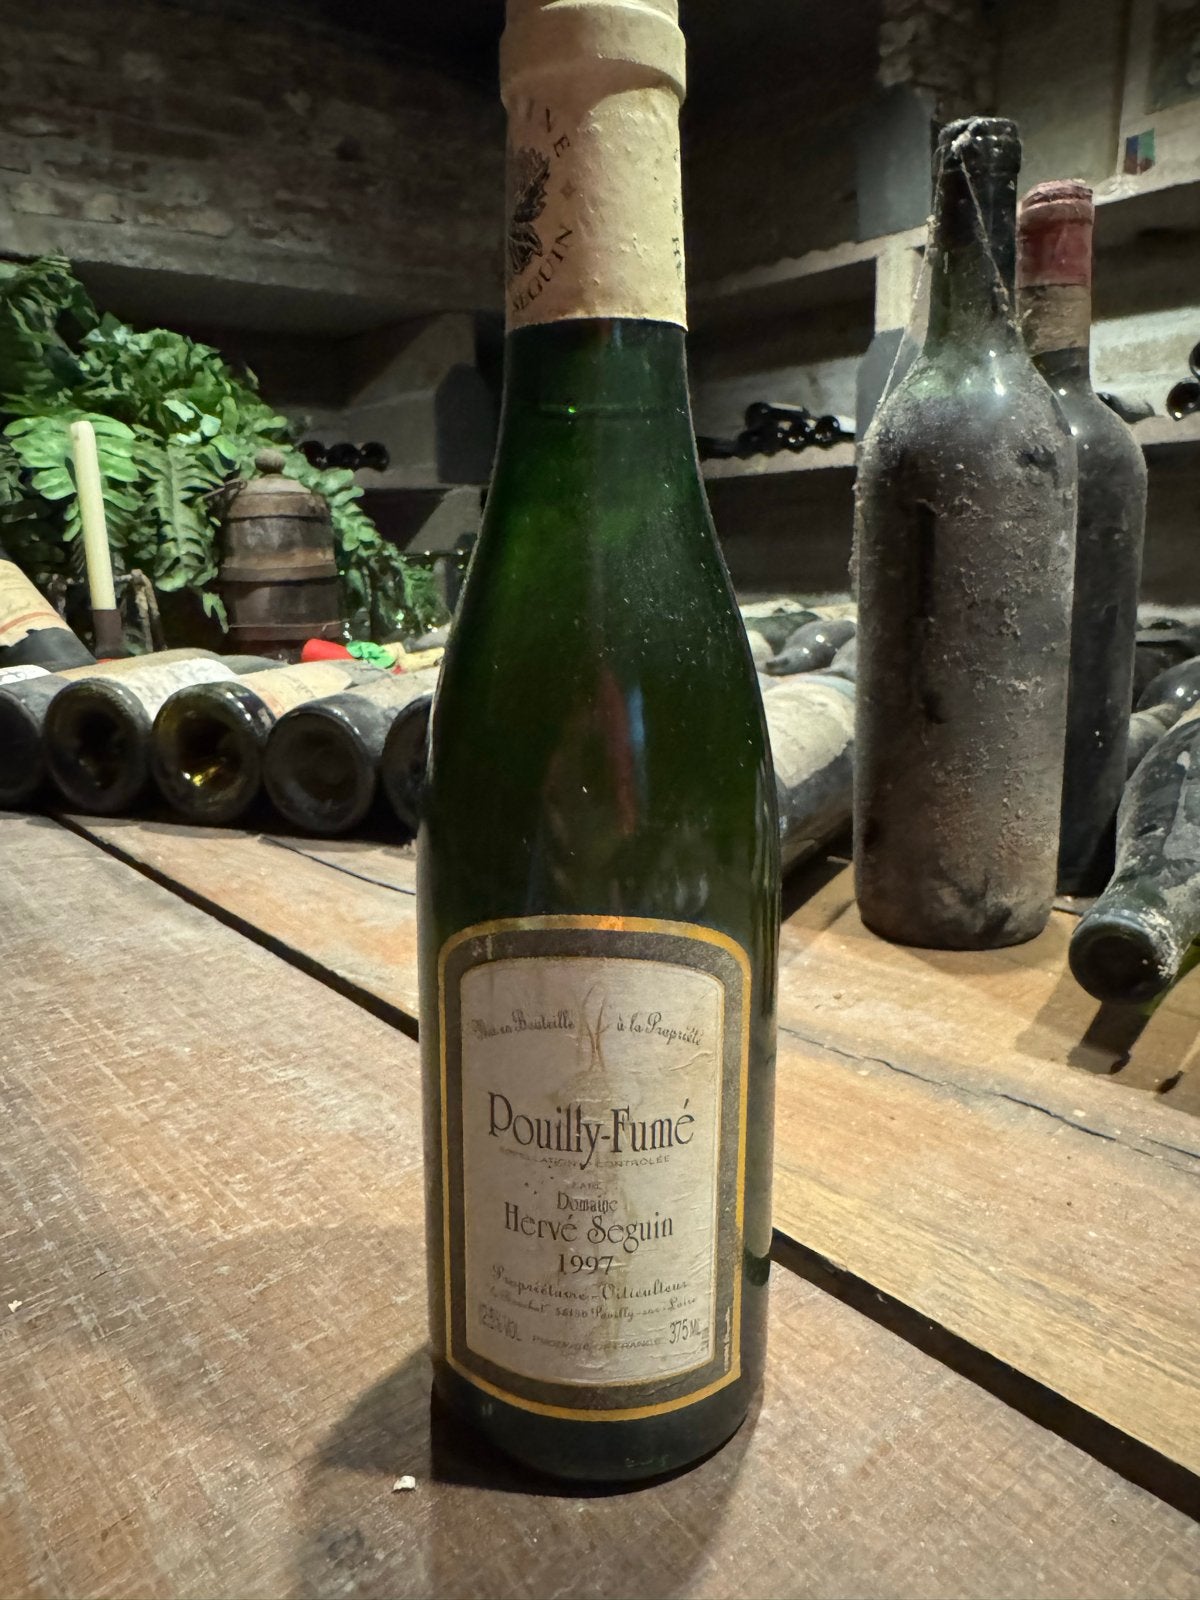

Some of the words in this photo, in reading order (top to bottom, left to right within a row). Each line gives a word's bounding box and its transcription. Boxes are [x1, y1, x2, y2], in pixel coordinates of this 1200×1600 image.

[629, 1012, 643, 1033] la
[488, 1091, 695, 1170] Pouilly-Fumé
[557, 1190, 618, 1213] Domaine
[504, 1201, 577, 1242] Hervé
[587, 1211, 673, 1254] Seguin
[558, 1253, 614, 1276] 1997
